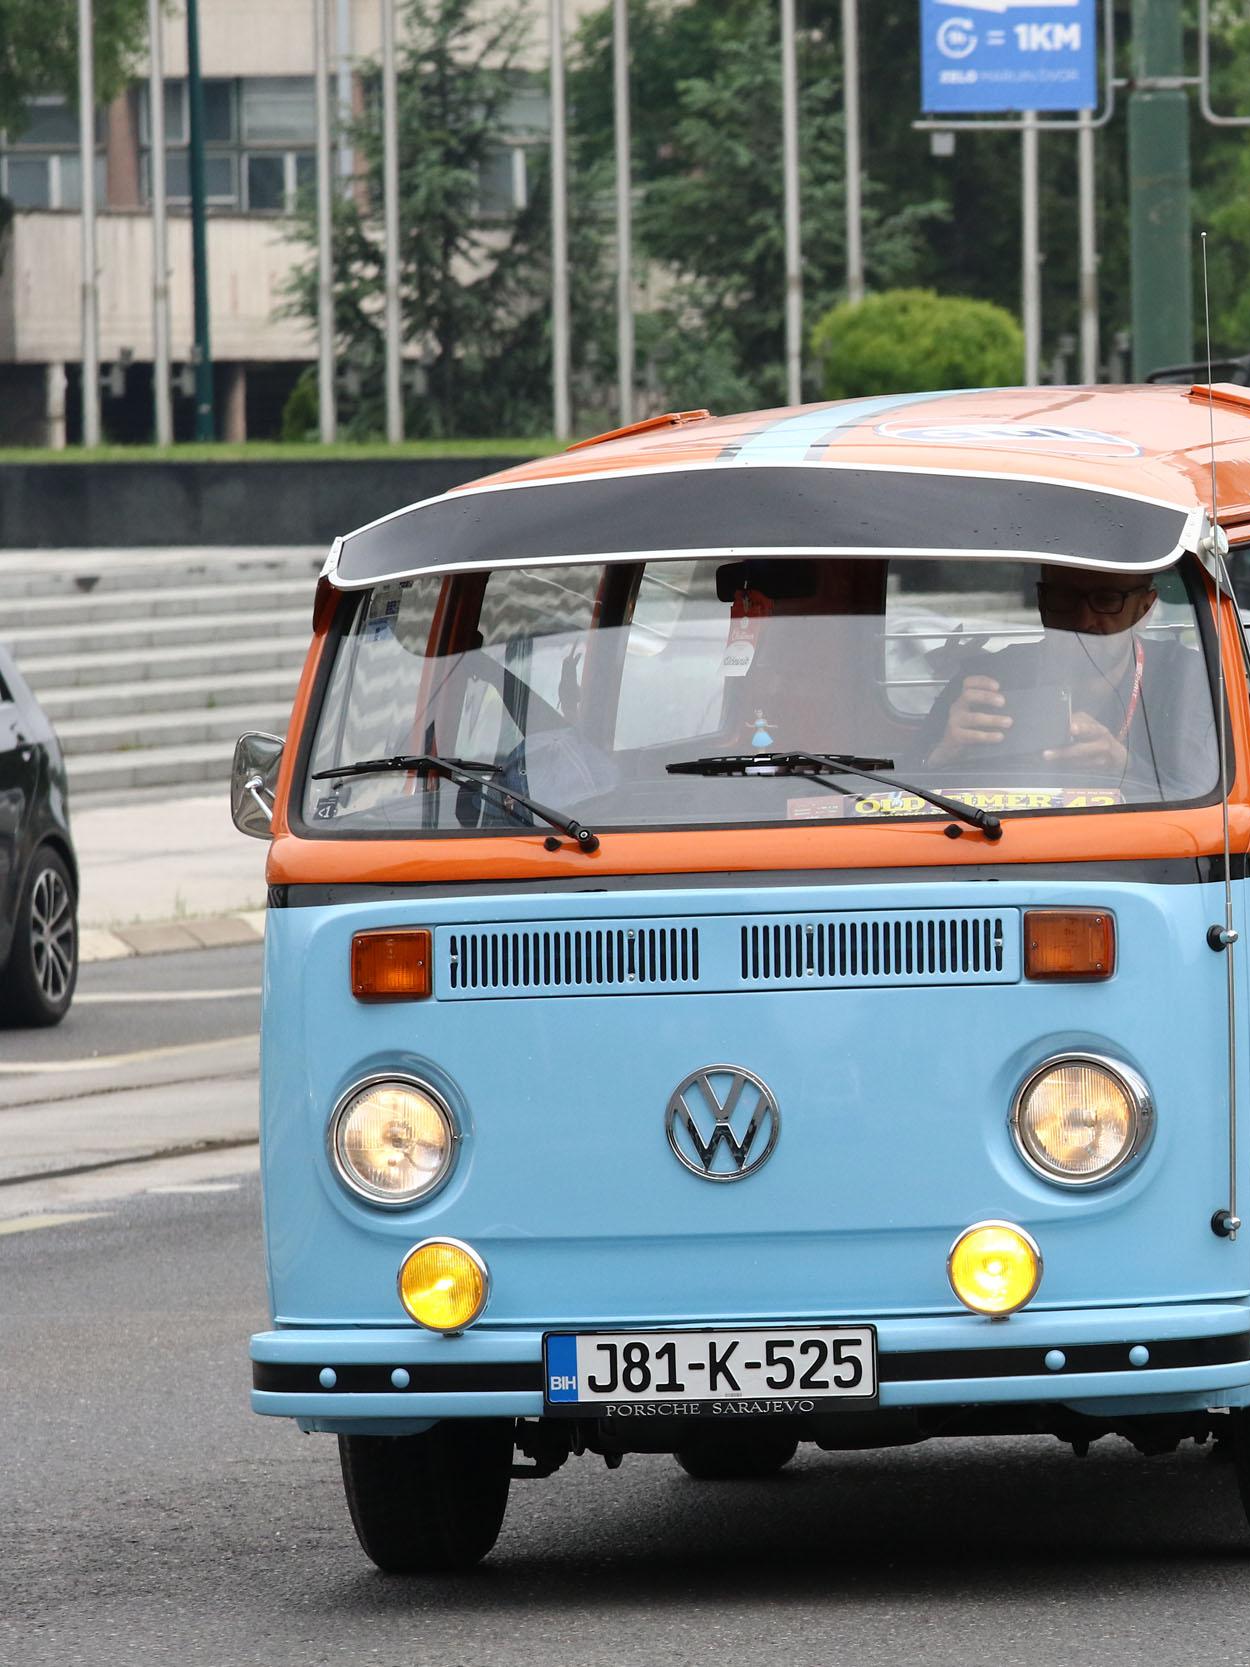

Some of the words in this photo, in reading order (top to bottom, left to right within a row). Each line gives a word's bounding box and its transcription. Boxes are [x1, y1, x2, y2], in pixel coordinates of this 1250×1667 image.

[1013, 23, 1081, 51] 1KM
[587, 1338, 863, 1393] J81-K-525
[550, 1376, 576, 1391] BIH
[605, 1403, 701, 1417] PORSCHE
[712, 1400, 815, 1415] SARAJEVO
